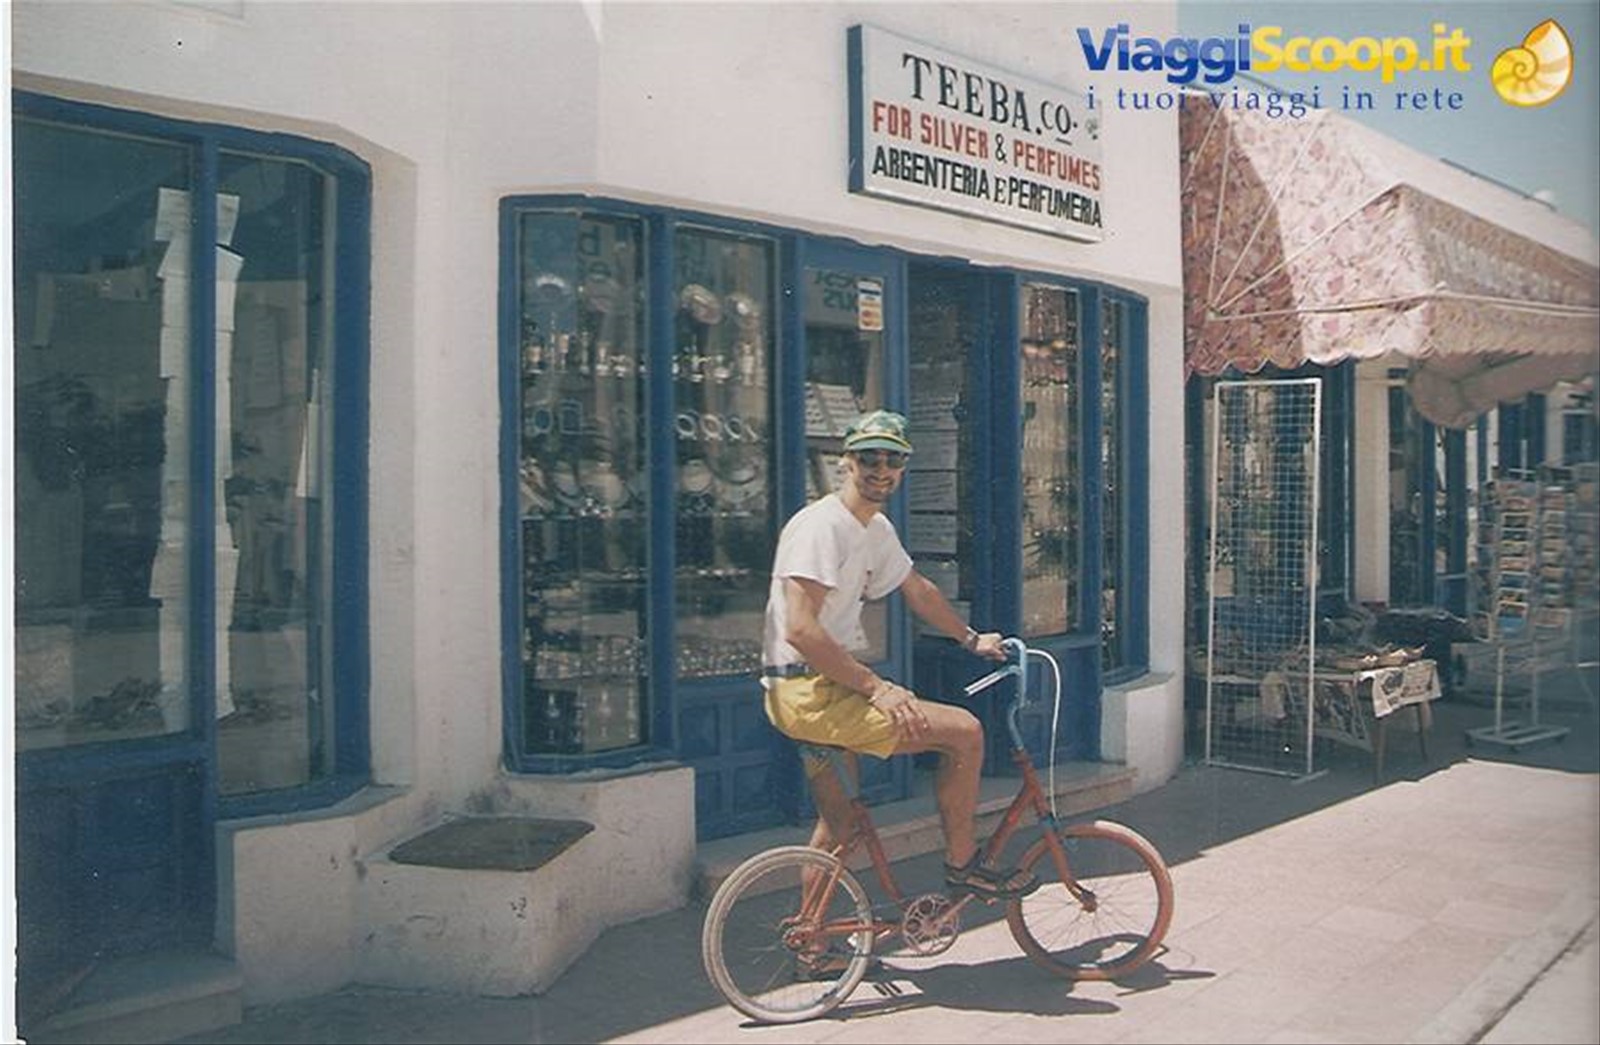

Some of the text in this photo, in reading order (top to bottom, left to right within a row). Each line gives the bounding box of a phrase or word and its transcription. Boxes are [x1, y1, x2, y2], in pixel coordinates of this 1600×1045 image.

[872, 146, 990, 201] ARGENTERIA
[1008, 179, 1103, 229] PERFUMERIA
[873, 101, 1100, 191] FOR SILVER & PERFUMES
